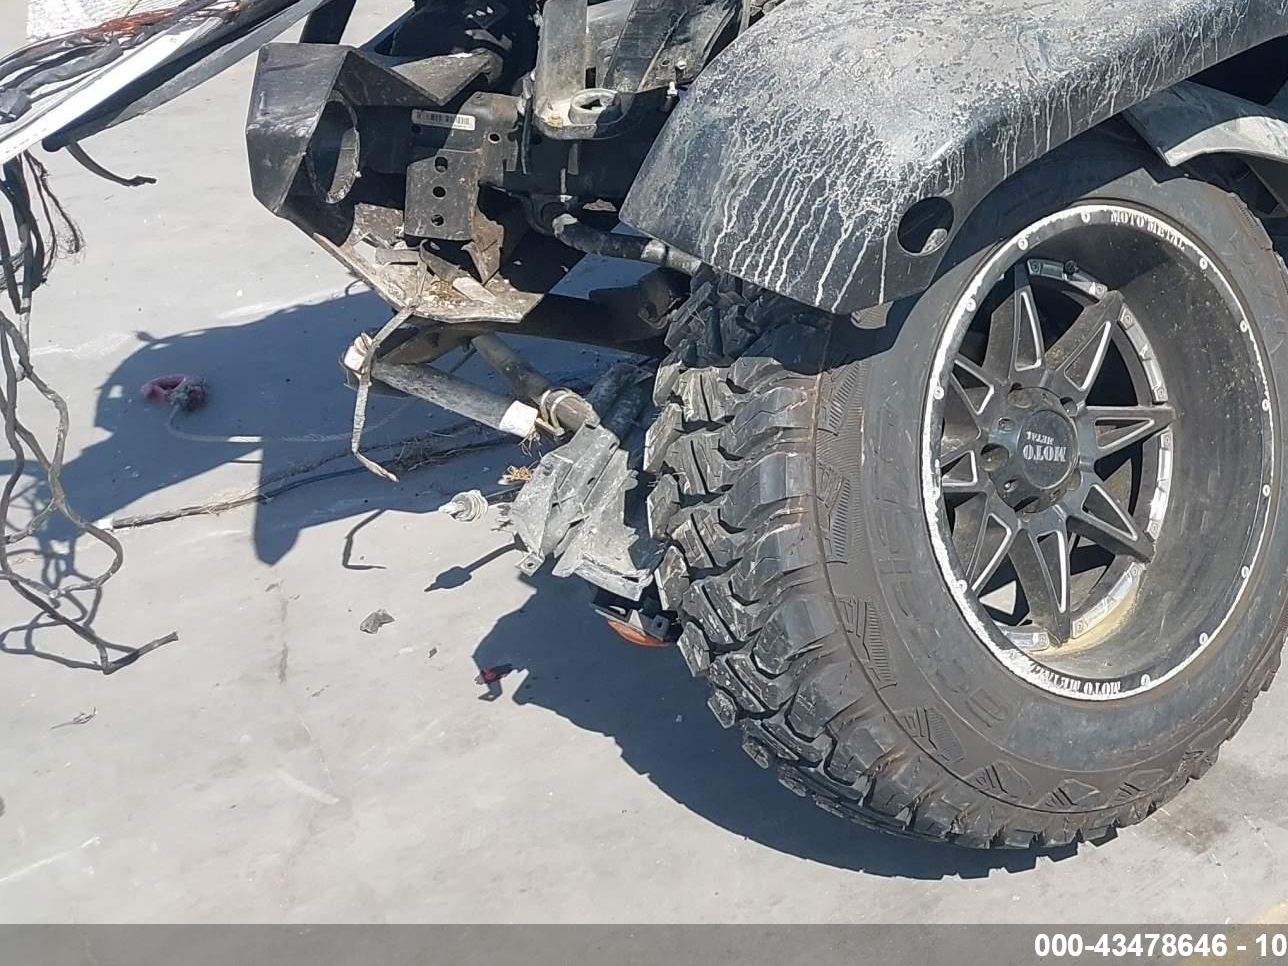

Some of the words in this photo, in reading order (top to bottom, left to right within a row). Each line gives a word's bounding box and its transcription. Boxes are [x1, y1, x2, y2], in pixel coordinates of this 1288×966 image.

[1110, 209, 1145, 228] MOTO
[1147, 219, 1186, 252] METAL
[1026, 430, 1055, 445] METAL
[1022, 444, 1067, 462] MOTO
[1083, 680, 1121, 696] MOTO
